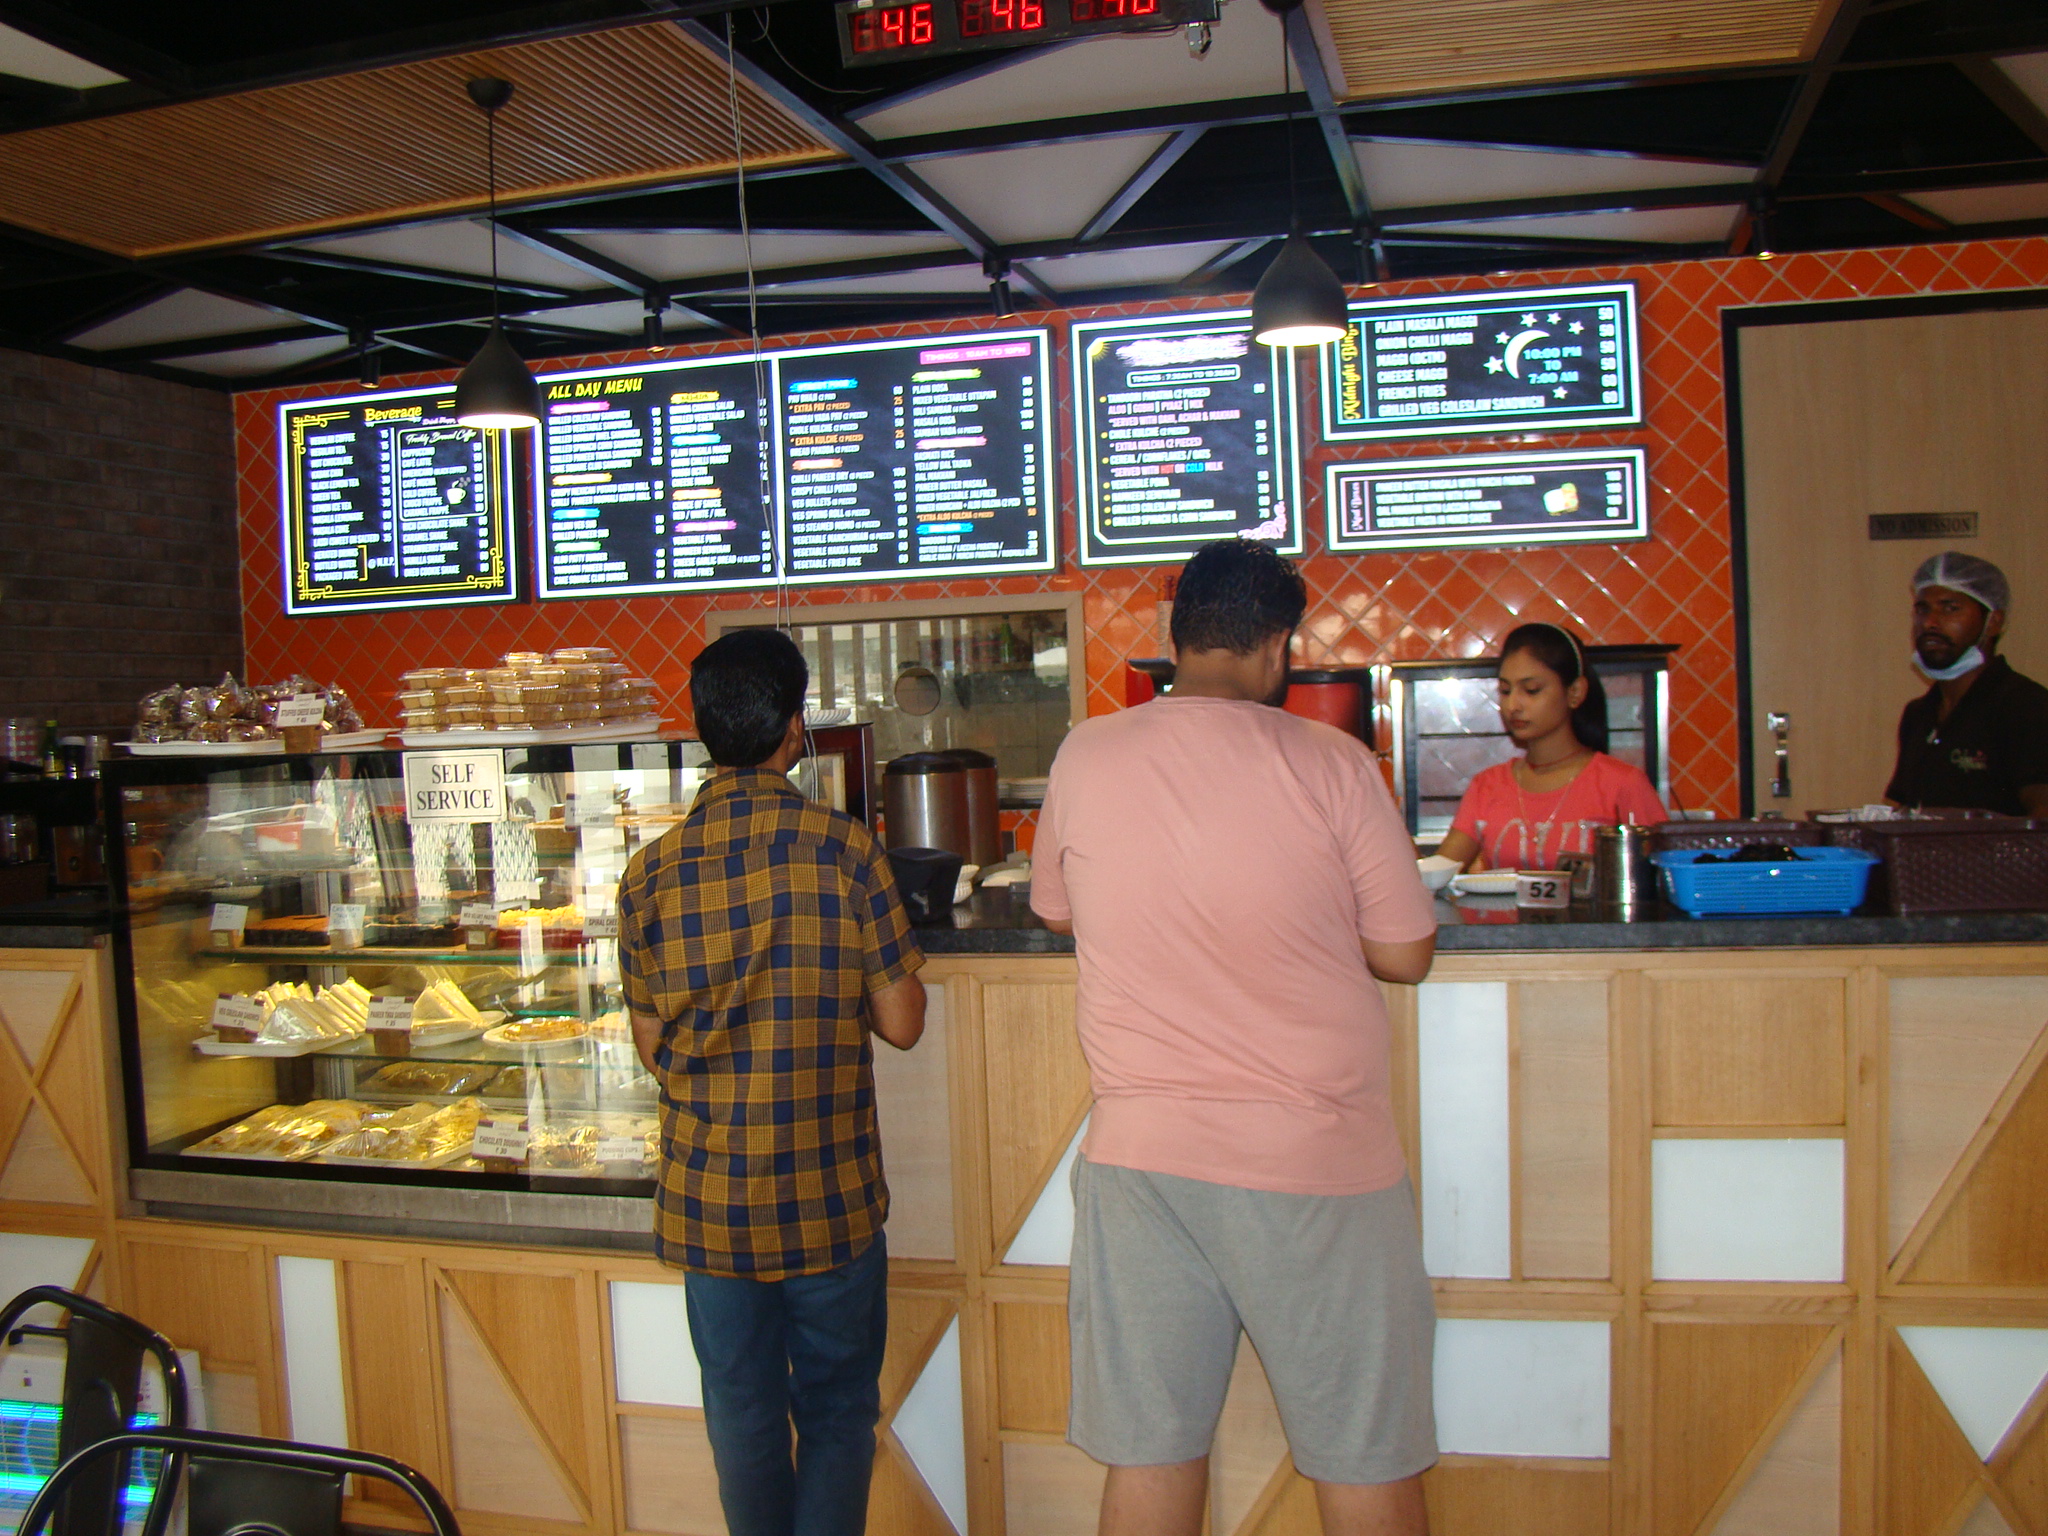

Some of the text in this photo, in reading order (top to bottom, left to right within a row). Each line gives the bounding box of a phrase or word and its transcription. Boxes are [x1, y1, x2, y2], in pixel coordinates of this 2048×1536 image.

[882, 4, 932, 45] 46
[1599, 307, 1614, 320] 50
[1375, 314, 1478, 333] PLAIN MASALA MAGGI
[1600, 324, 1614, 338] 50
[1408, 334, 1440, 347] CHILLI
[1440, 332, 1473, 345] MAGGI
[1562, 346, 1582, 358] PM
[1600, 340, 1615, 354] 50
[925, 352, 959, 360] TIMINGS
[1376, 353, 1408, 366] MAGGI
[1544, 360, 1562, 371] TO
[1601, 357, 1616, 370] 50
[1377, 367, 1447, 383] CHEESE MAGGI
[1528, 371, 1579, 384] 7:00 AM
[548, 378, 642, 398] ALL DAY MENU
[912, 384, 931, 394] PLAIN
[1342, 364, 1361, 420] Midnight
[1378, 384, 1447, 399] FRENCH FRIES
[793, 403, 812, 412] EXTRA
[813, 402, 825, 411] PAV
[894, 396, 902, 405] 25
[1378, 402, 1420, 419] GRILLED
[1419, 401, 1440, 417] VEG
[1491, 395, 1545, 412] SANDWICH
[364, 406, 423, 422] Beverage
[795, 436, 814, 445] EXTRA
[814, 434, 838, 444] KULCHE
[896, 430, 904, 438] 25
[791, 474, 811, 483] CHILLI
[811, 472, 835, 482] PANEER
[812, 484, 833, 494] CHILLI
[792, 511, 805, 520] VEG
[792, 523, 805, 532] VEG
[1877, 517, 1970, 533] NO ADMISSION
[432, 763, 476, 784] SELF
[417, 789, 494, 810] SERVICE
[1530, 882, 1556, 898] 52
[479, 1136, 526, 1148] CHOCOLATE DOUGHNUT
